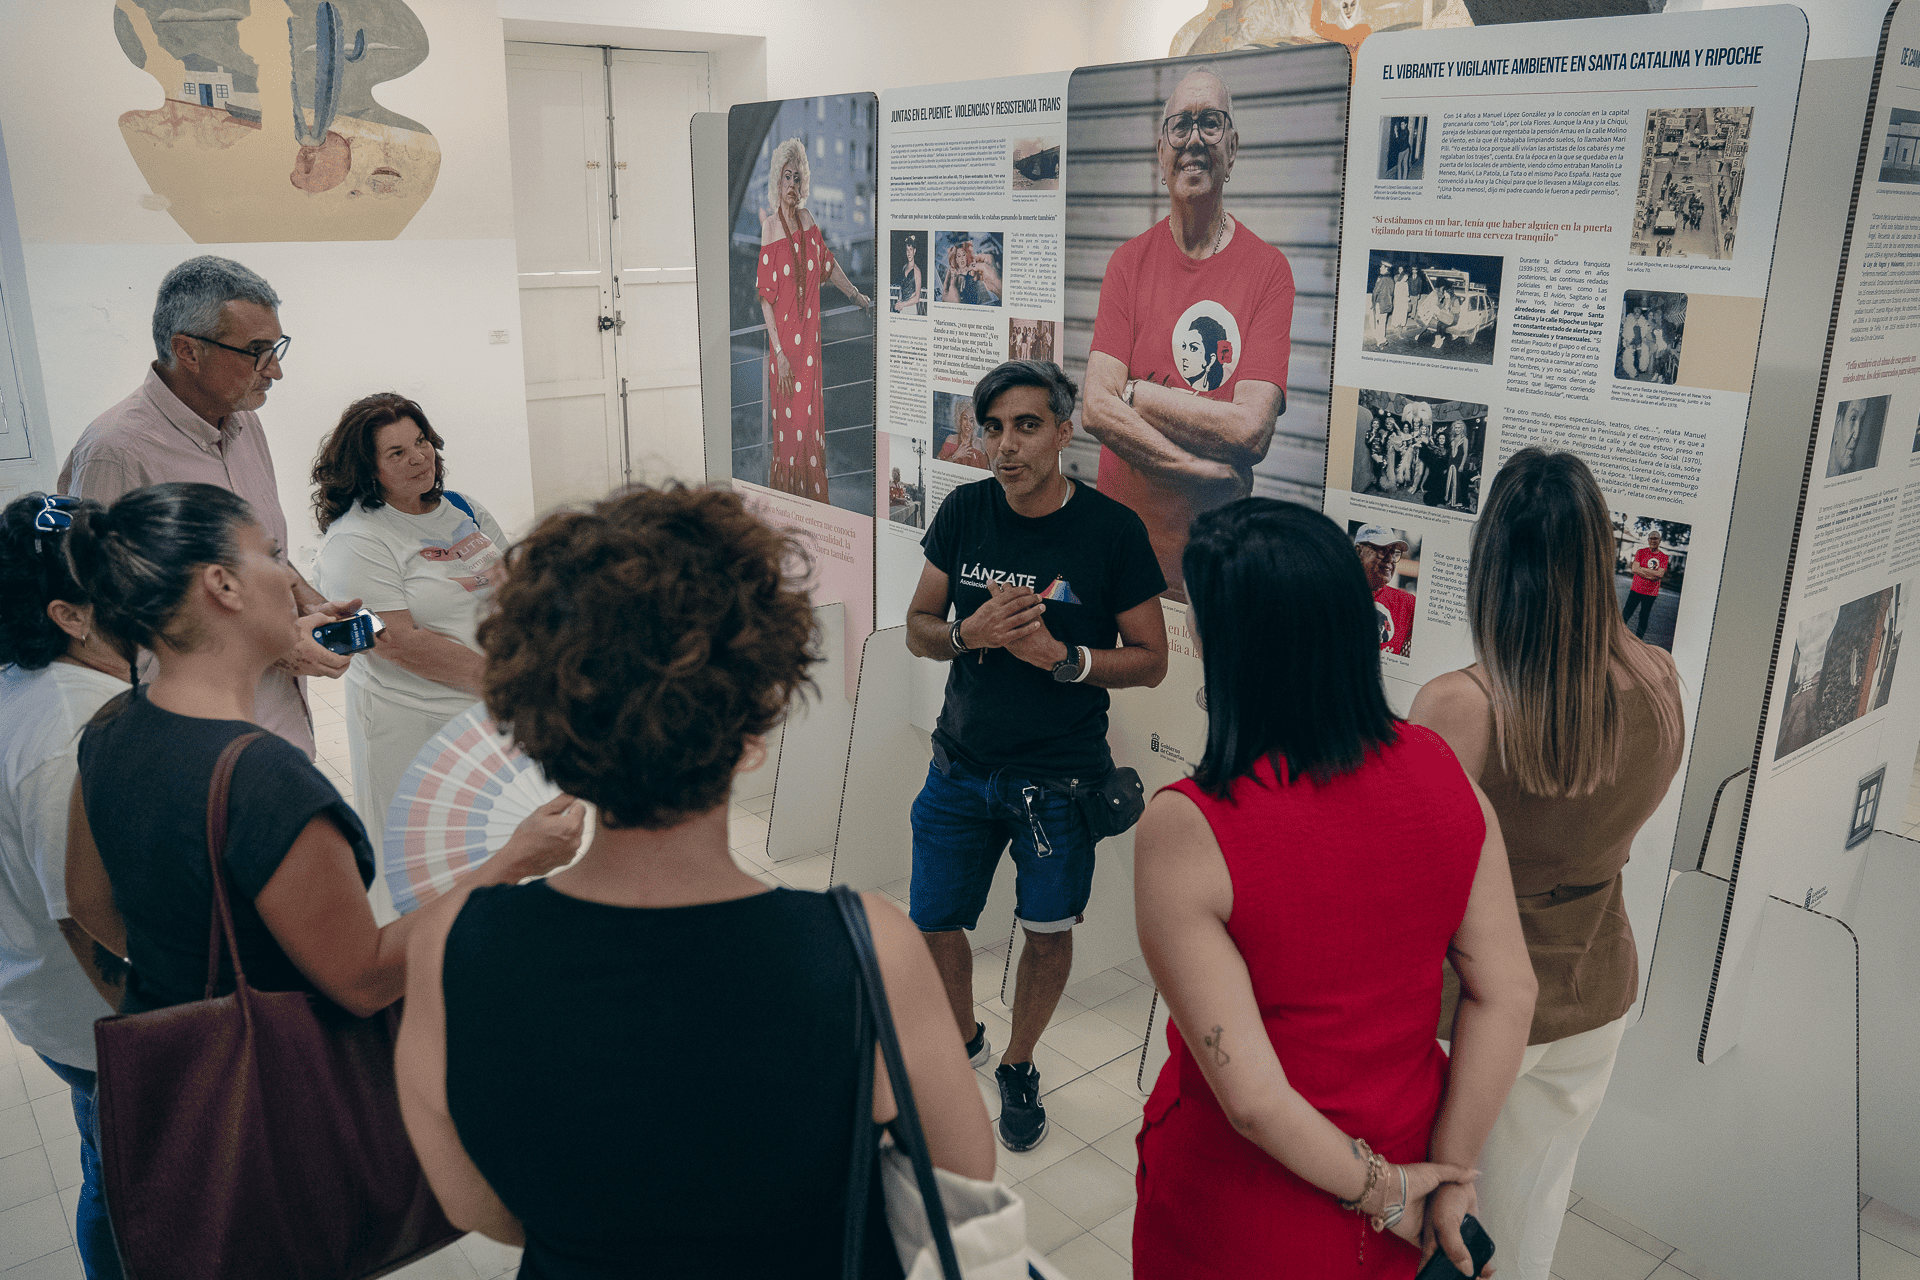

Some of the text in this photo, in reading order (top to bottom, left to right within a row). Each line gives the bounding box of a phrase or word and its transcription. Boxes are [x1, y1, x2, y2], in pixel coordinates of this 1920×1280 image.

[1383, 46, 1763, 79] EL VIBRANTE Y VIGILANTE AMBIENTE EN SANTA CATALINA Y RIPOCHE
[891, 97, 1060, 122] JUNTAS EN EL PUENTE: VIOLENCIAS Y RESISTENCIA TRANS
[1384, 217, 1422, 226] estábamos
[1464, 219, 1483, 227] tenía
[1503, 220, 1526, 229] haber
[1528, 221, 1558, 231] alguien
[1574, 223, 1581, 231] la
[1583, 225, 1612, 233] puerta
[1371, 227, 1404, 236] vigilando
[1425, 228, 1432, 236] tú
[1483, 232, 1512, 240] cerveza
[1584, 260, 1610, 268] franquista
[1518, 274, 1547, 282] posteriores,
[1514, 306, 1546, 314] alrededores
[1564, 309, 1583, 318] Parque
[1558, 317, 1580, 325] Ripoche
[1589, 320, 1603, 328] lugar
[1531, 411, 1552, 419] mundo,
[1569, 416, 1606, 426] espectáculos,
[1610, 420, 1631, 430] teatros,
[1684, 430, 1706, 438] Manuel
[776, 507, 855, 538] Santa Cruz entera me conocía
[846, 540, 850, 549] la
[831, 549, 854, 563] también
[961, 563, 1036, 589] LÁNZATE
[960, 579, 987, 588] Asociación
[1168, 625, 1179, 635] en
[1168, 639, 1181, 653] día
[1184, 647, 1189, 655] a
